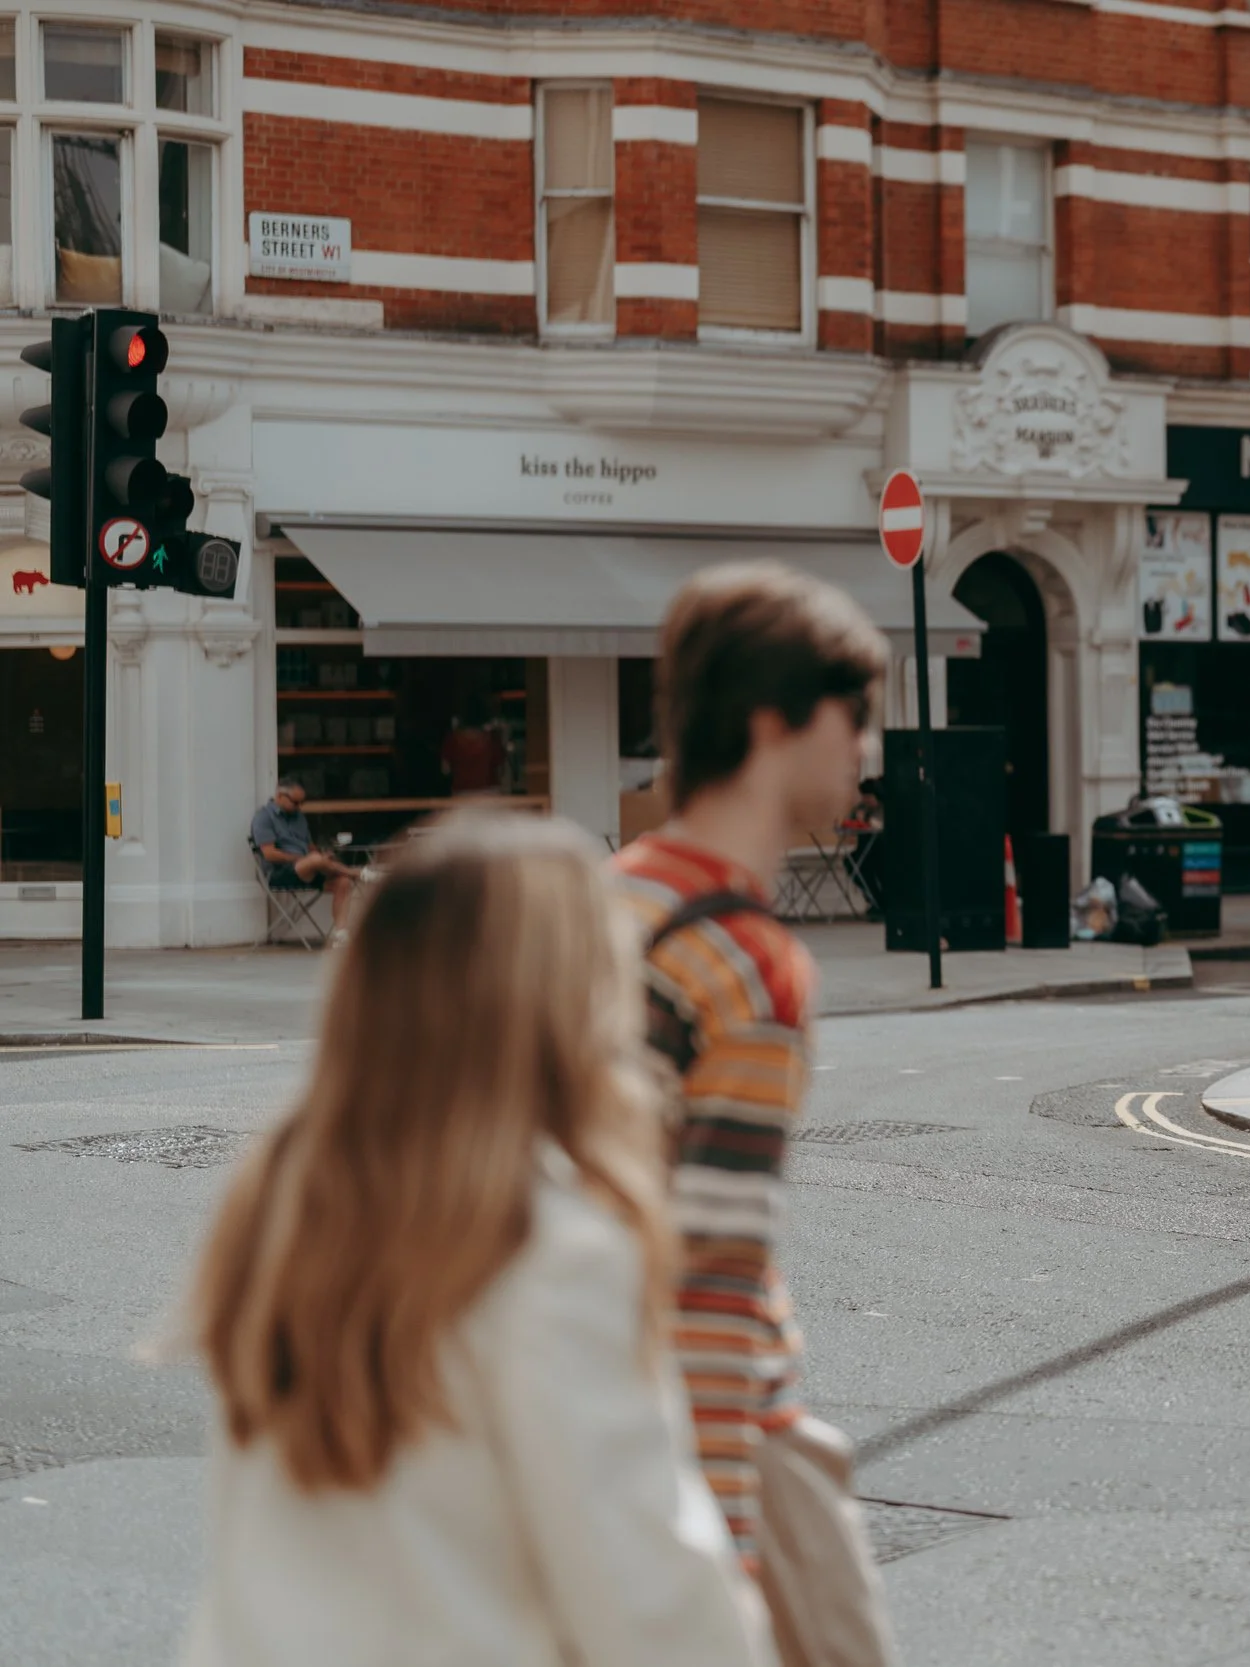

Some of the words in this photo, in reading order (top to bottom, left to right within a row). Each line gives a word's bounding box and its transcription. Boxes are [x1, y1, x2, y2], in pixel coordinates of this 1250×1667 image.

[261, 220, 329, 241] BERNERS
[262, 240, 315, 258] STREET
[322, 244, 341, 260] W1
[520, 454, 558, 477] kiss
[564, 456, 595, 478] the
[600, 456, 657, 485] hippo
